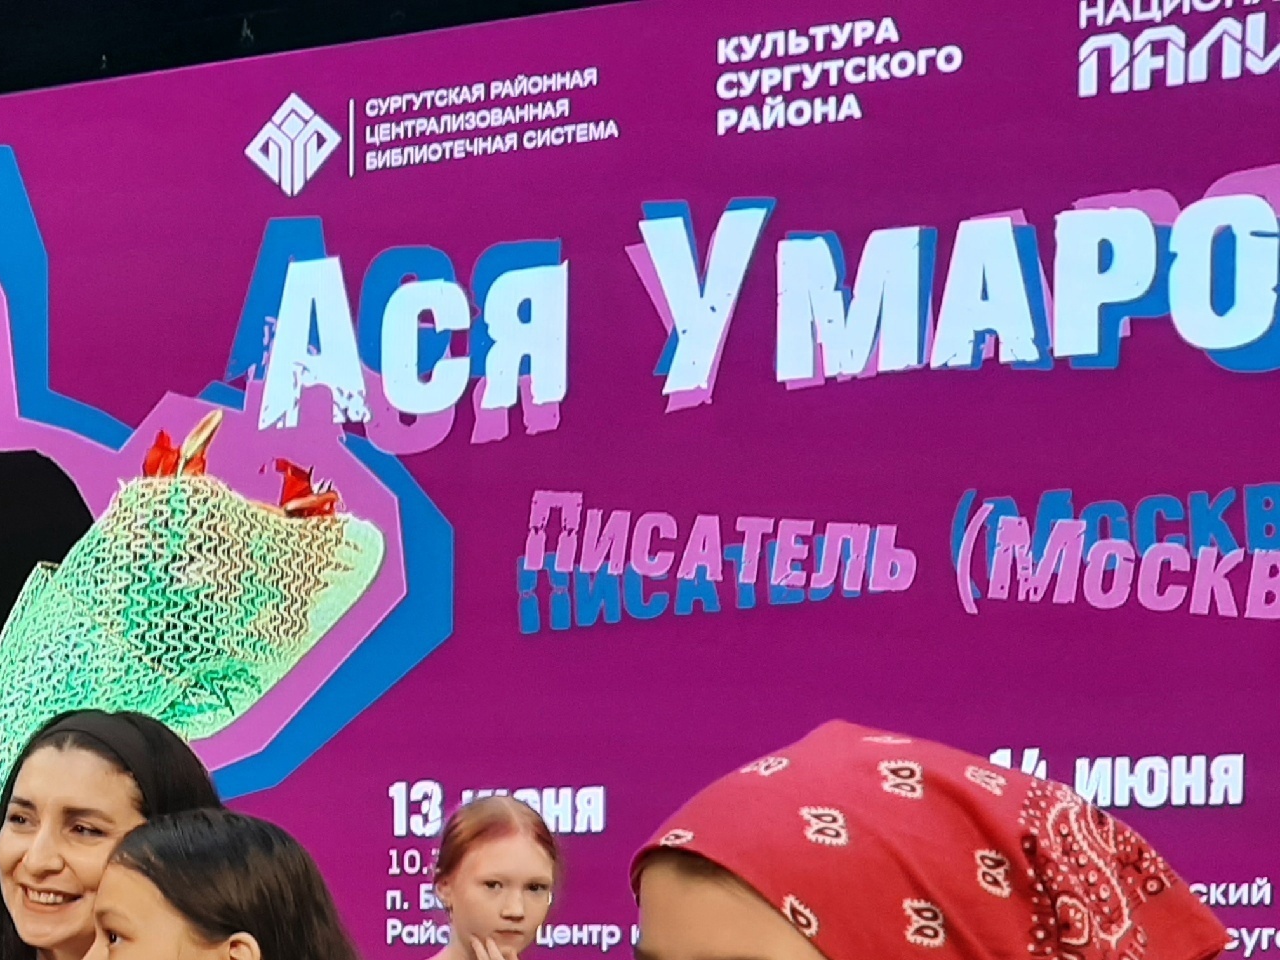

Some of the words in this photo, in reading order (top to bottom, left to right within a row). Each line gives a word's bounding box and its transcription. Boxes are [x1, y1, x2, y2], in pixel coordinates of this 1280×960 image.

[717, 17, 900, 65] КУЛЬТУРА
[365, 83, 486, 118] СУРГУТСКАЯ
[490, 66, 598, 99] РАЙОННАЯ
[716, 45, 964, 100] СУРГУТСКОГО
[365, 97, 570, 146] ЦЕНТРАЛИЗОВАННАЯ
[717, 94, 863, 136] РАЙОНА
[365, 132, 518, 171] БИБЛИОТЕЧНАЯ
[523, 119, 620, 150] СИСТЕМА
[388, 780, 443, 838] 13
[536, 923, 621, 952] центр
